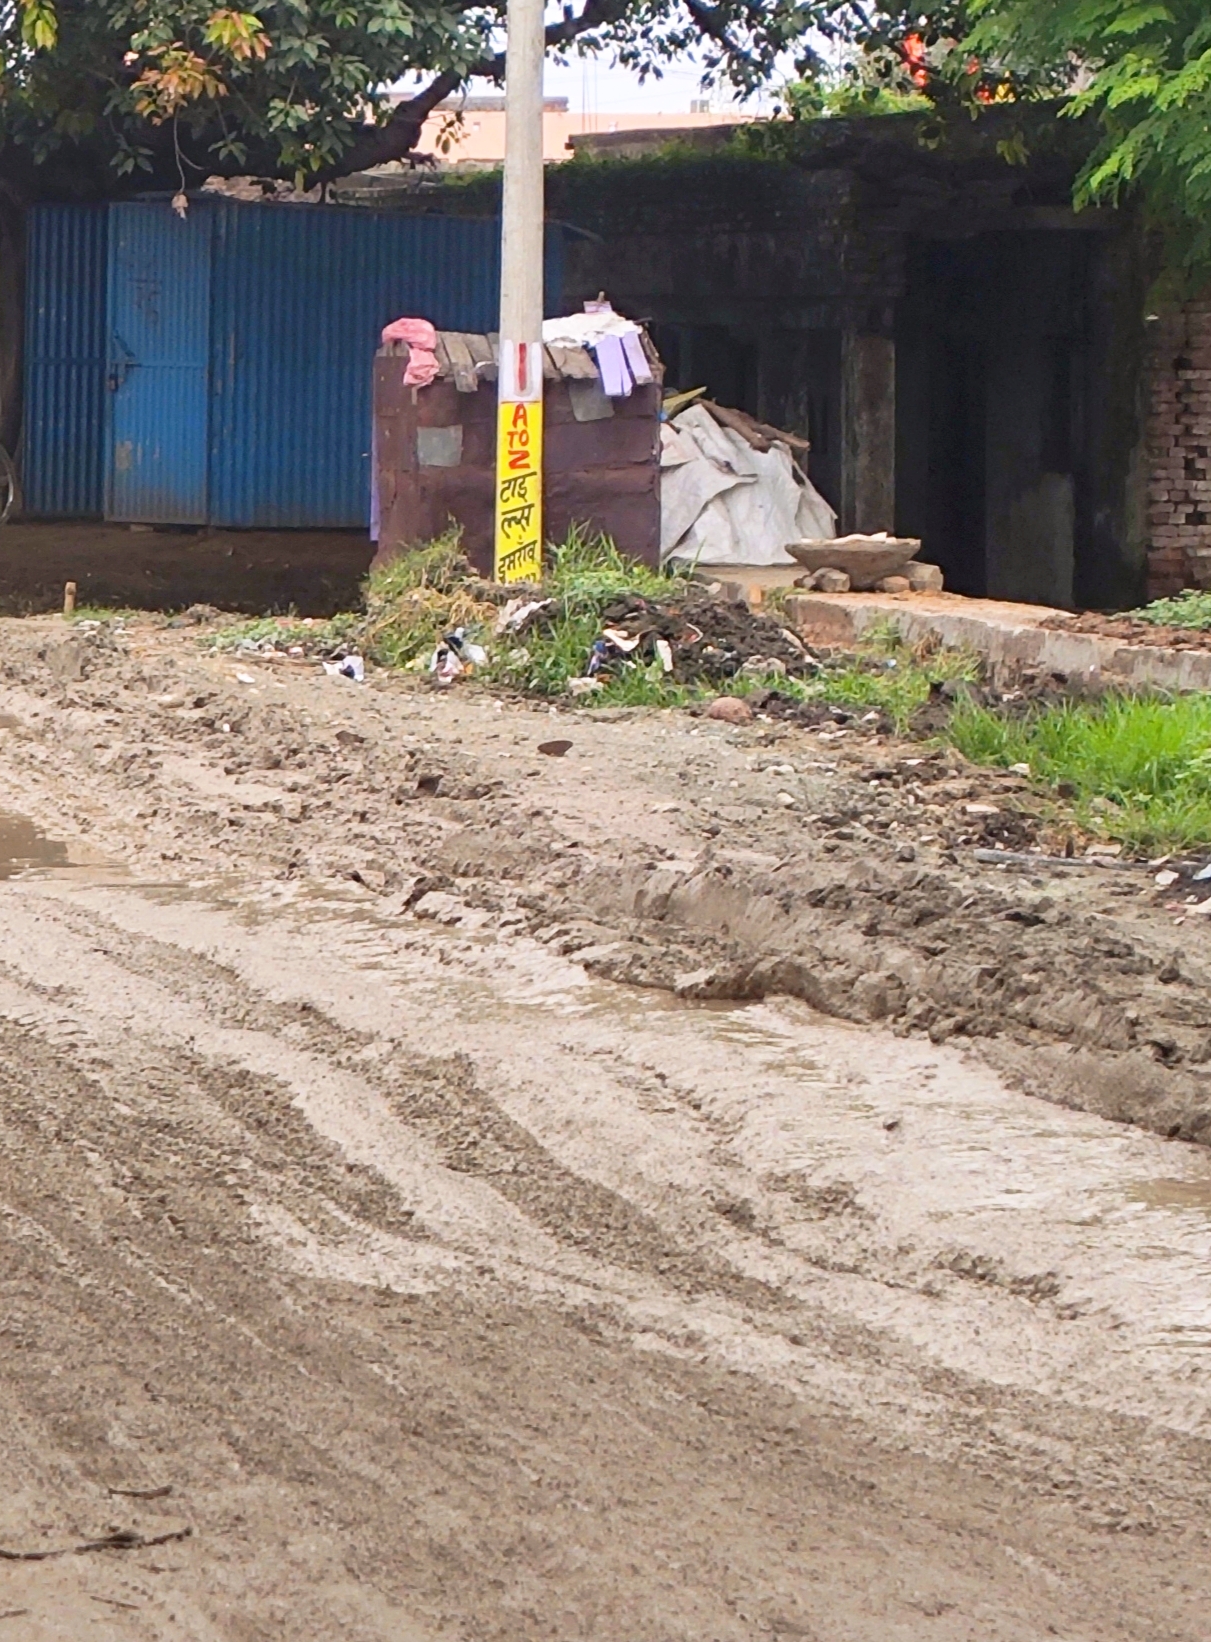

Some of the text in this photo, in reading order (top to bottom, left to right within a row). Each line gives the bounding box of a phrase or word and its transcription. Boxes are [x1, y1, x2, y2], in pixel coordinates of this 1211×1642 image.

[512, 402, 528, 428] A
[507, 429, 529, 449] TO
[508, 450, 531, 470] Z
